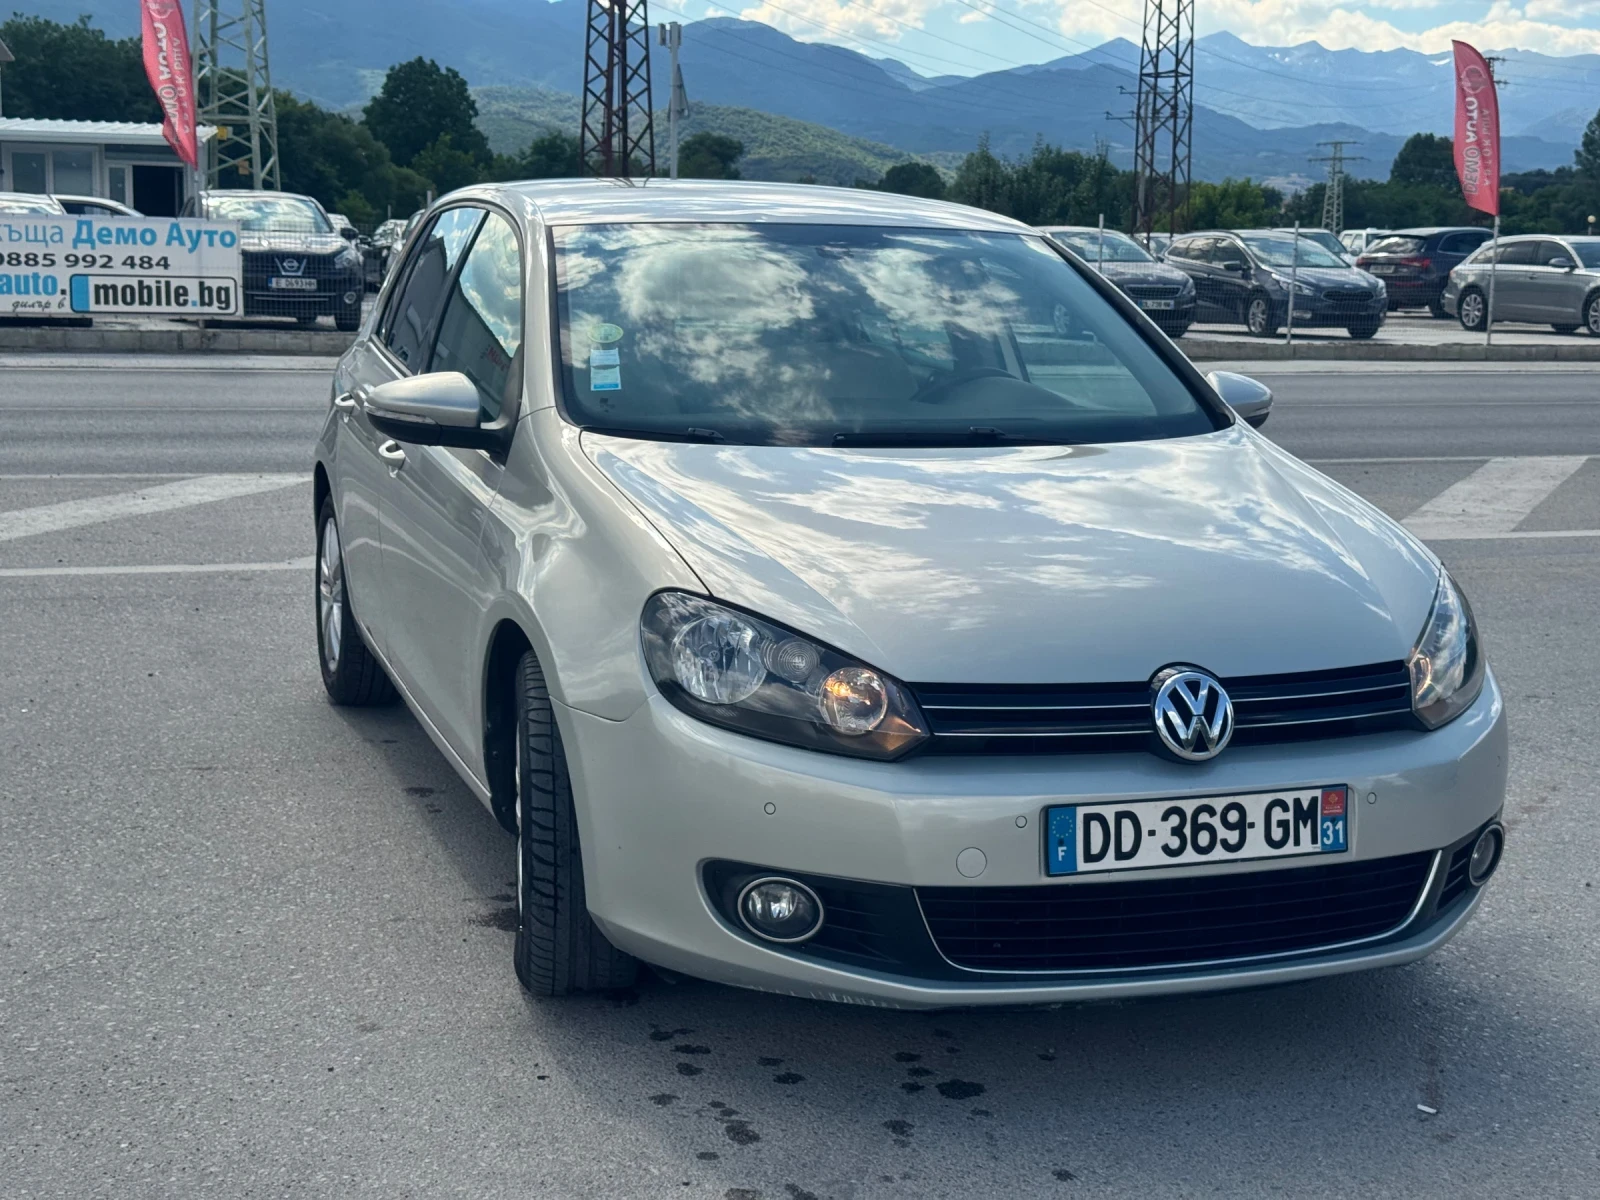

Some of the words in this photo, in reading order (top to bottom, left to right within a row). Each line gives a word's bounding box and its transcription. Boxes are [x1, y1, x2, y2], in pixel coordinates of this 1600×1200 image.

[72, 219, 157, 250] Демо
[165, 222, 237, 254] Ауто
[64, 253, 114, 269] 992
[121, 255, 171, 270] 484
[12, 300, 51, 312] дилър
[94, 279, 231, 311] mobile.bg
[1083, 796, 1319, 864] DD-369-GM
[1322, 821, 1345, 846] 31
[1058, 846, 1068, 862] F
